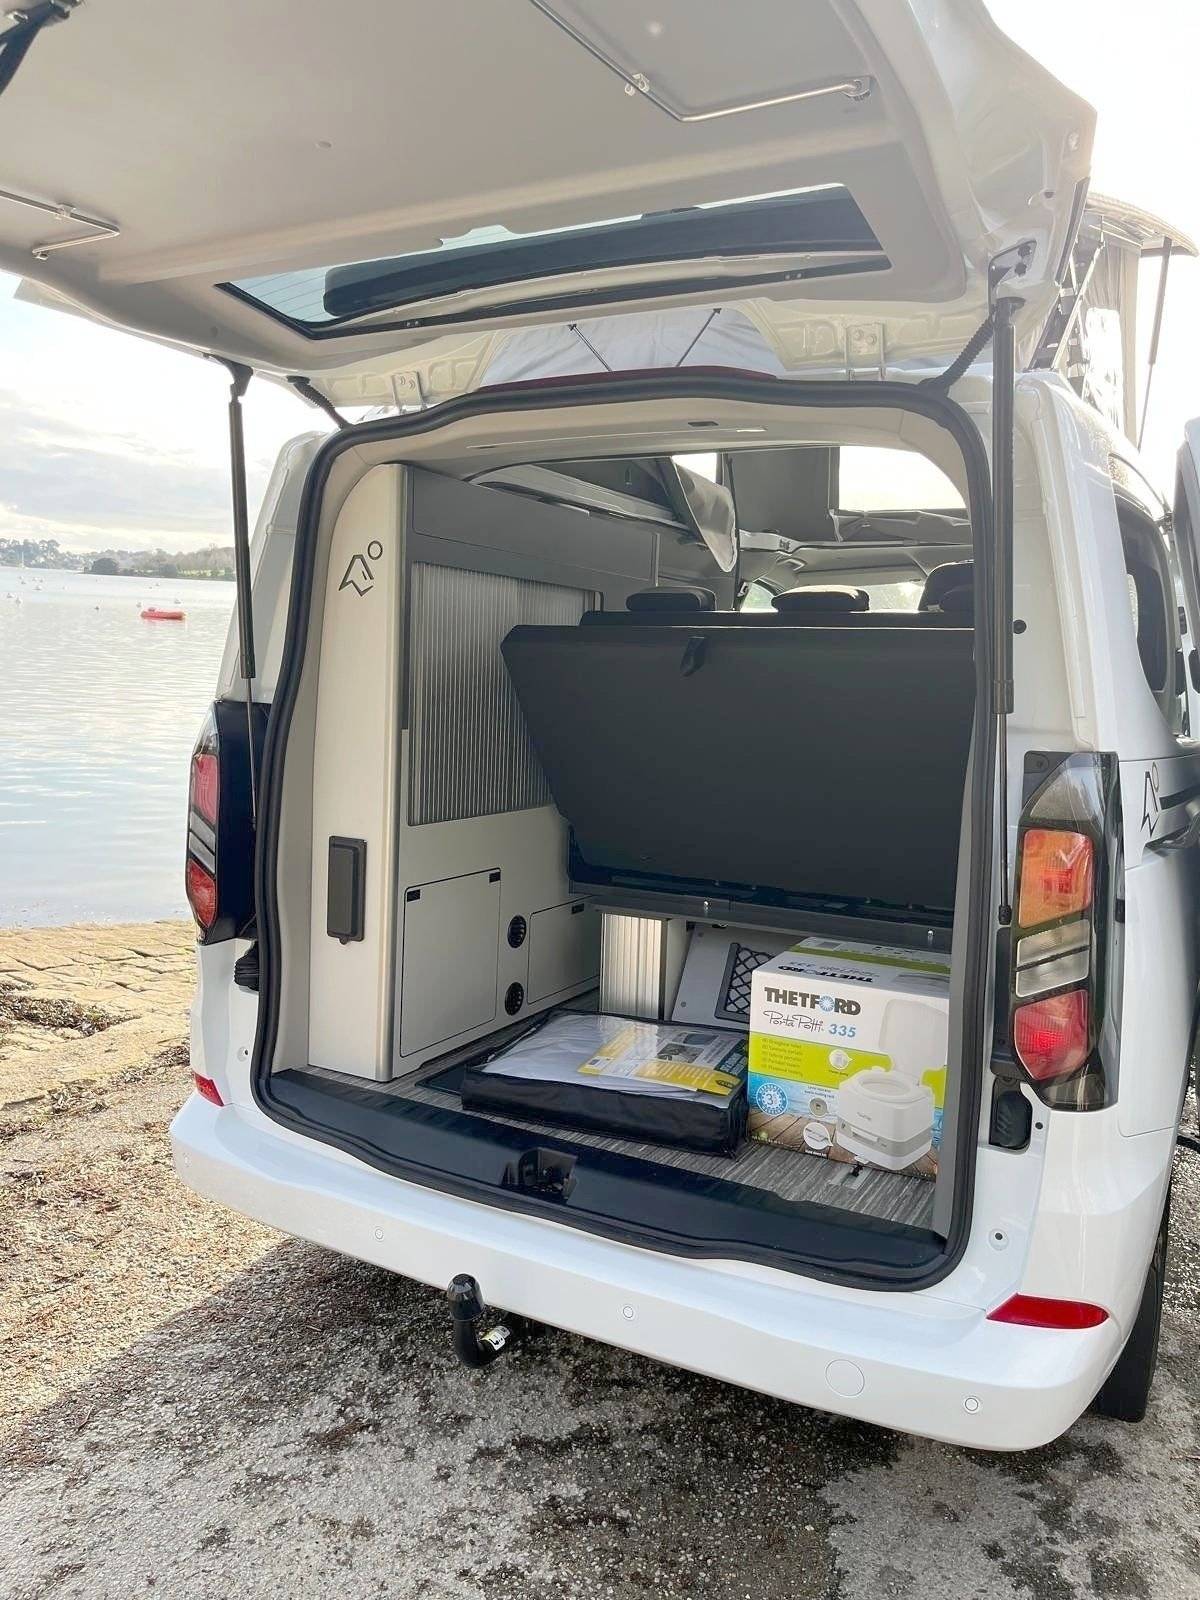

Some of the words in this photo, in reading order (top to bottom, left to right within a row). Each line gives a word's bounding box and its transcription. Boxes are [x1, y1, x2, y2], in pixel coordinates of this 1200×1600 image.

[764, 986, 861, 1015] THETFORD
[763, 1010, 794, 1028] Porta
[792, 1014, 823, 1033] Potti
[828, 1023, 856, 1038] 335
